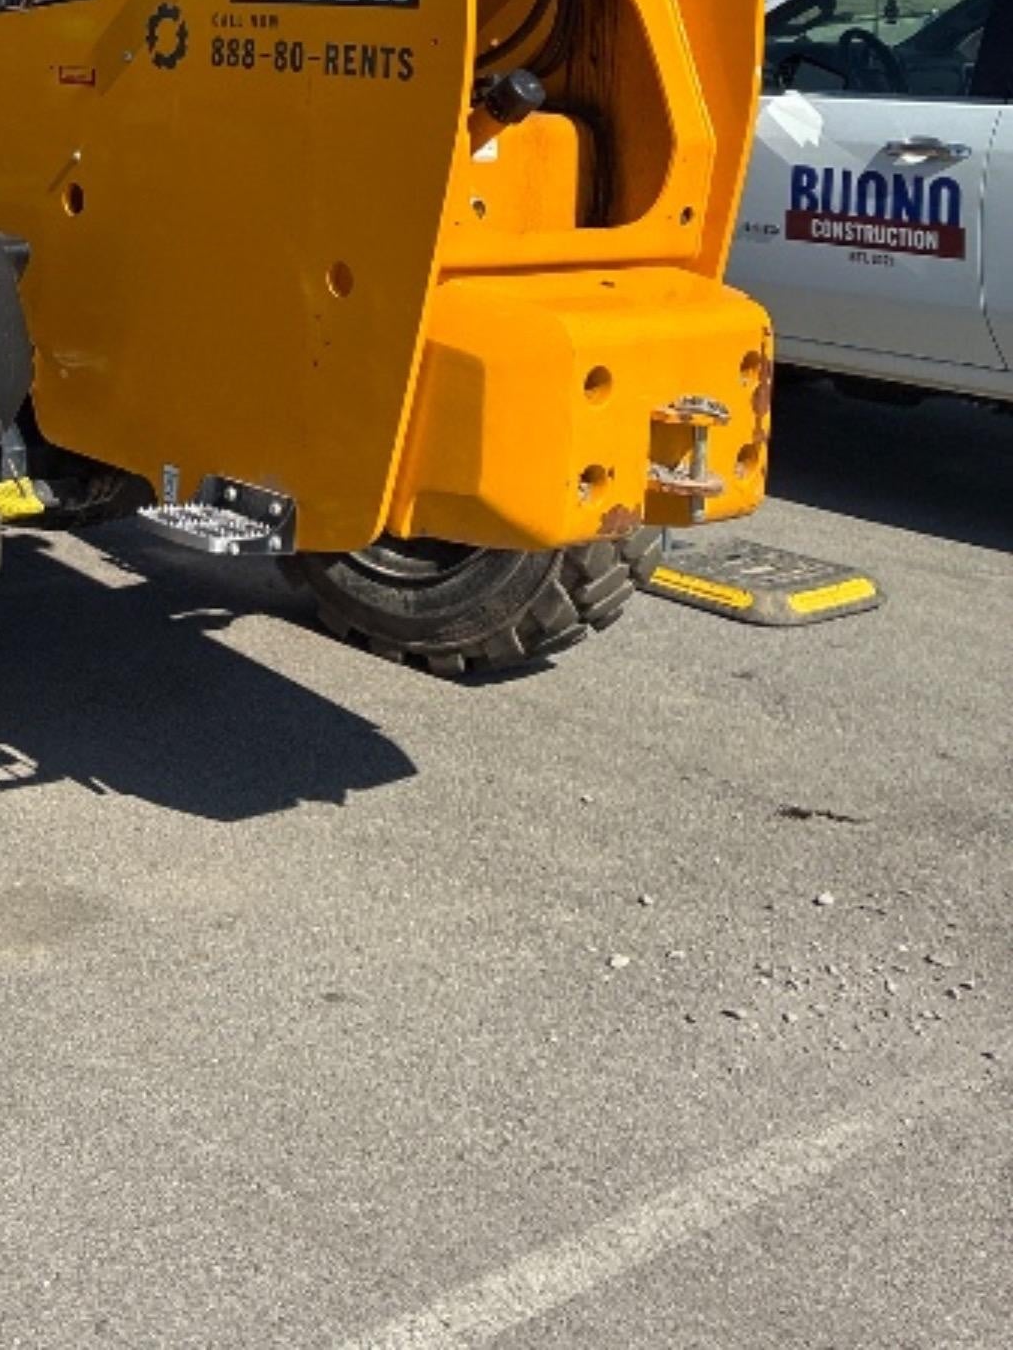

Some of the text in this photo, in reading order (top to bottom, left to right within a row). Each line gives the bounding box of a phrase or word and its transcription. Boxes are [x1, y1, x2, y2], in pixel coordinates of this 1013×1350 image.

[211, 37, 415, 82] 888-80-RENTS
[791, 164, 961, 228] BUONO
[810, 217, 938, 251] CONSTRUCTION
